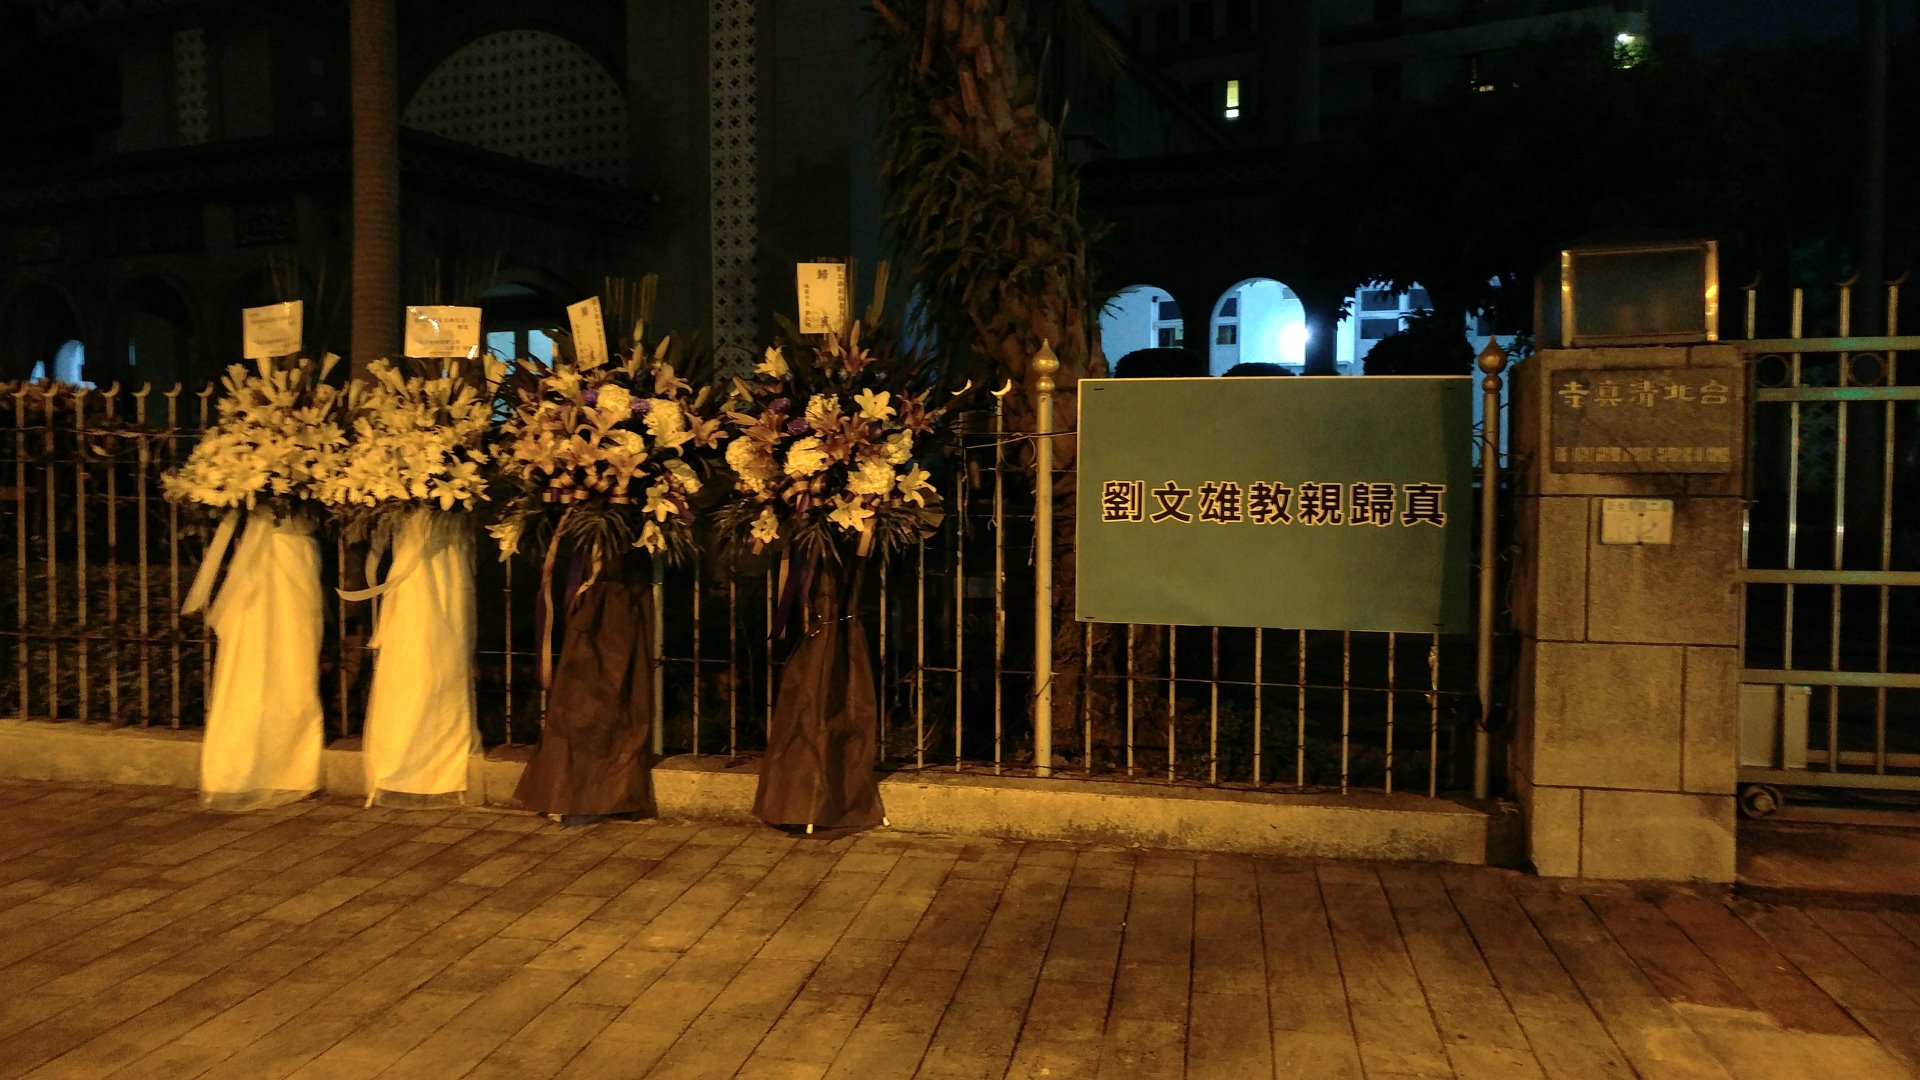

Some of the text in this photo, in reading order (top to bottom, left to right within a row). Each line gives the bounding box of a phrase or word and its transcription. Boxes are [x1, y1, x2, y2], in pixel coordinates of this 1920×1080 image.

[1101, 479, 1448, 527] 劉文雄教親歸真
